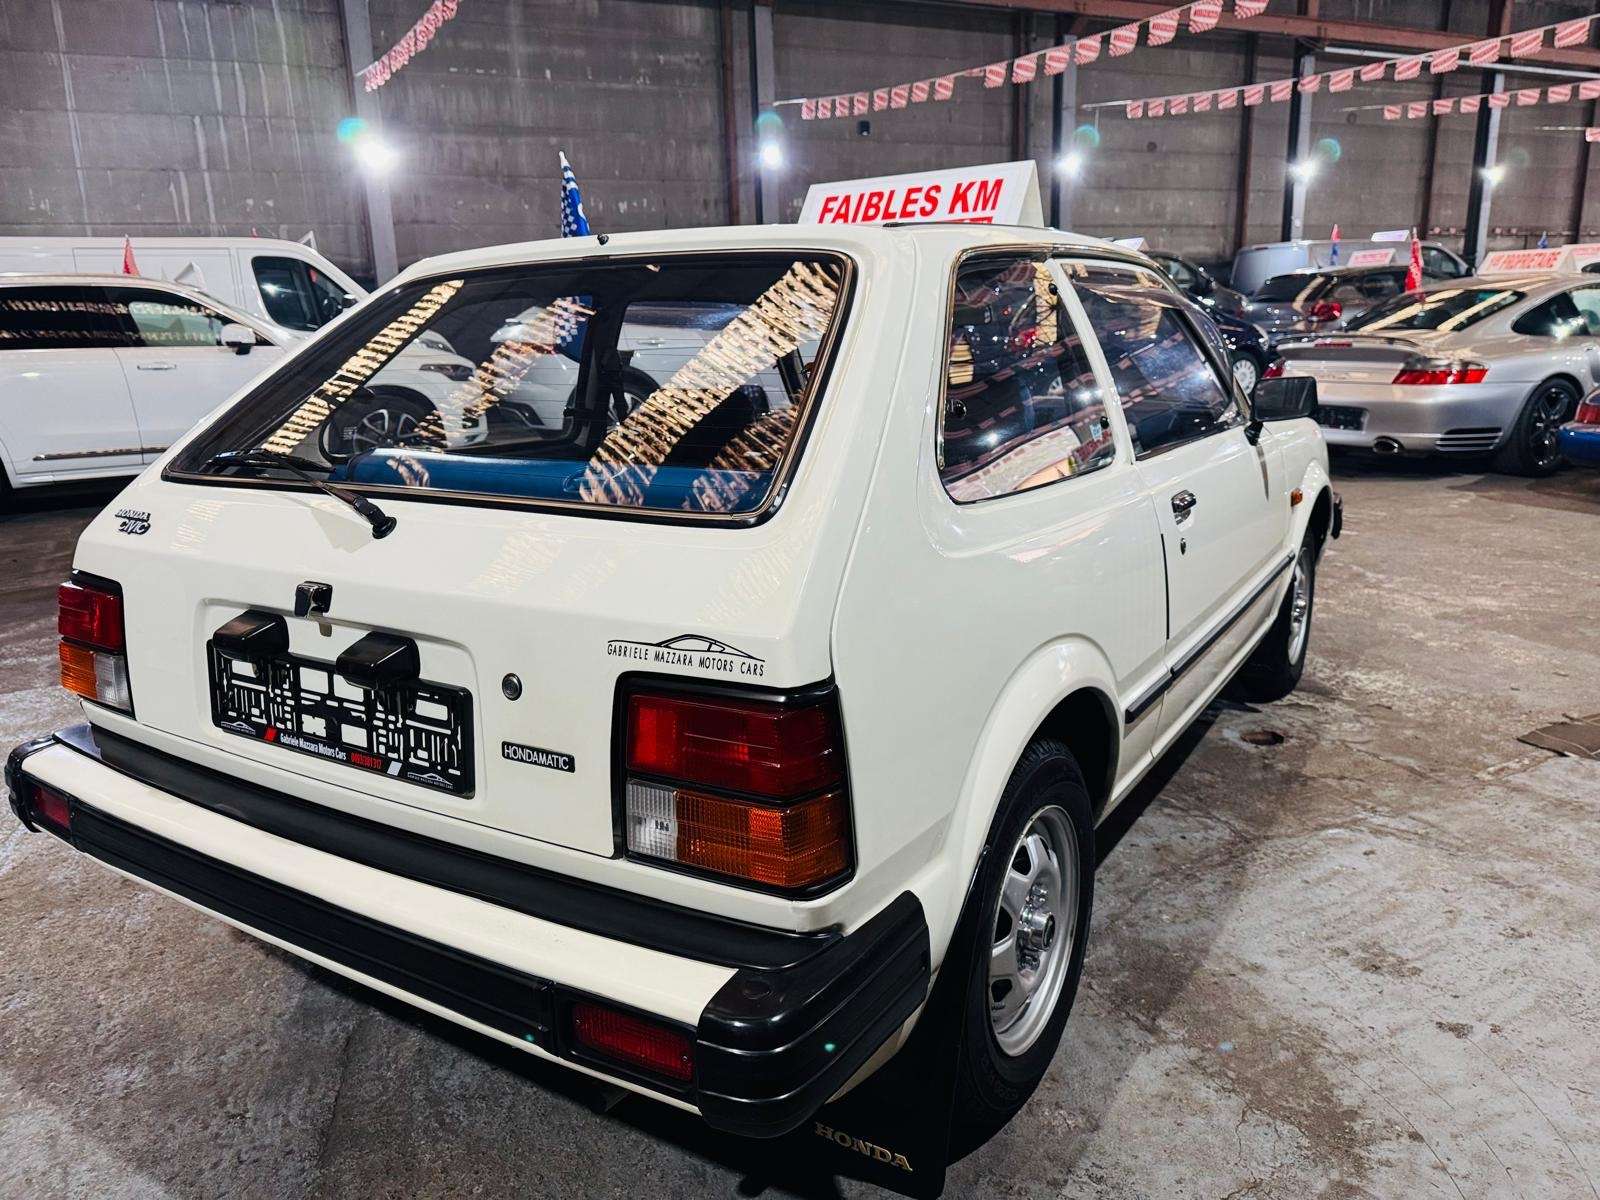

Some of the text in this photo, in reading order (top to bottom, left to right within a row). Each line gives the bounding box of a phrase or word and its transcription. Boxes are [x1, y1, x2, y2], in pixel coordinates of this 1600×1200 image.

[818, 179, 1004, 224] FAIBLES KM
[119, 520, 150, 535] CIVIC
[607, 644, 764, 677] GABRIELE MAZZARA MOTORS CARS
[280, 733, 298, 747] Gabriele
[299, 738, 318, 752] Mazzara
[319, 743, 335, 757] Motors
[335, 747, 346, 761] Cars
[504, 744, 569, 770] HONDAMATIC
[815, 1122, 913, 1172] HONDA
